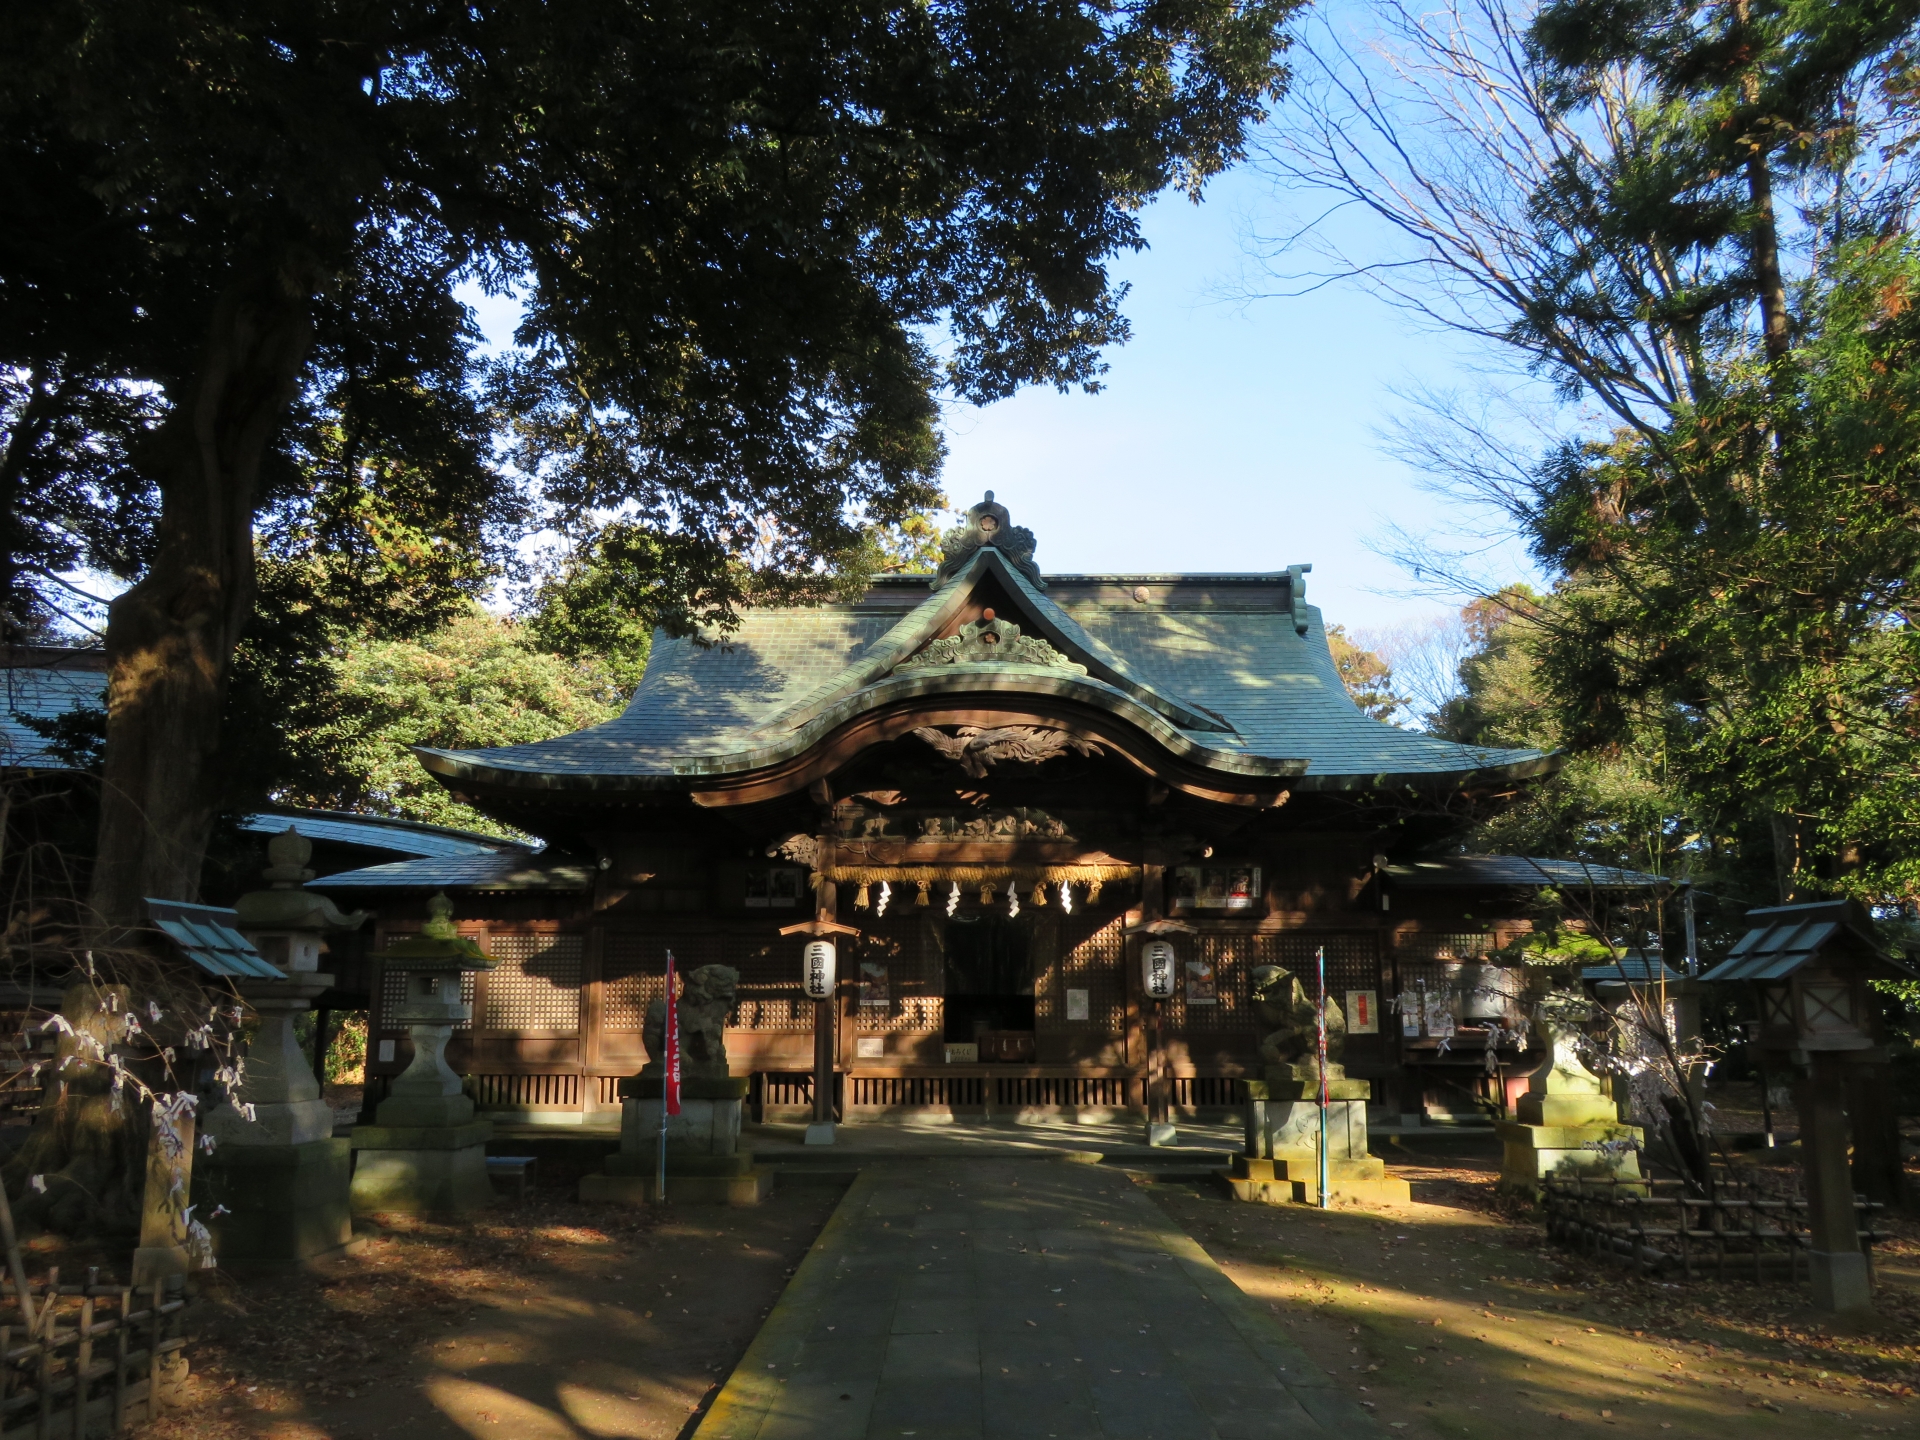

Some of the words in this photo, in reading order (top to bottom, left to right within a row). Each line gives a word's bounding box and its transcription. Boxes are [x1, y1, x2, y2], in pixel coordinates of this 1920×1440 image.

[809, 944, 826, 995] 三國神社
[1151, 945, 1168, 995] 三國神社
[951, 1048, 972, 1056] おみくじ
